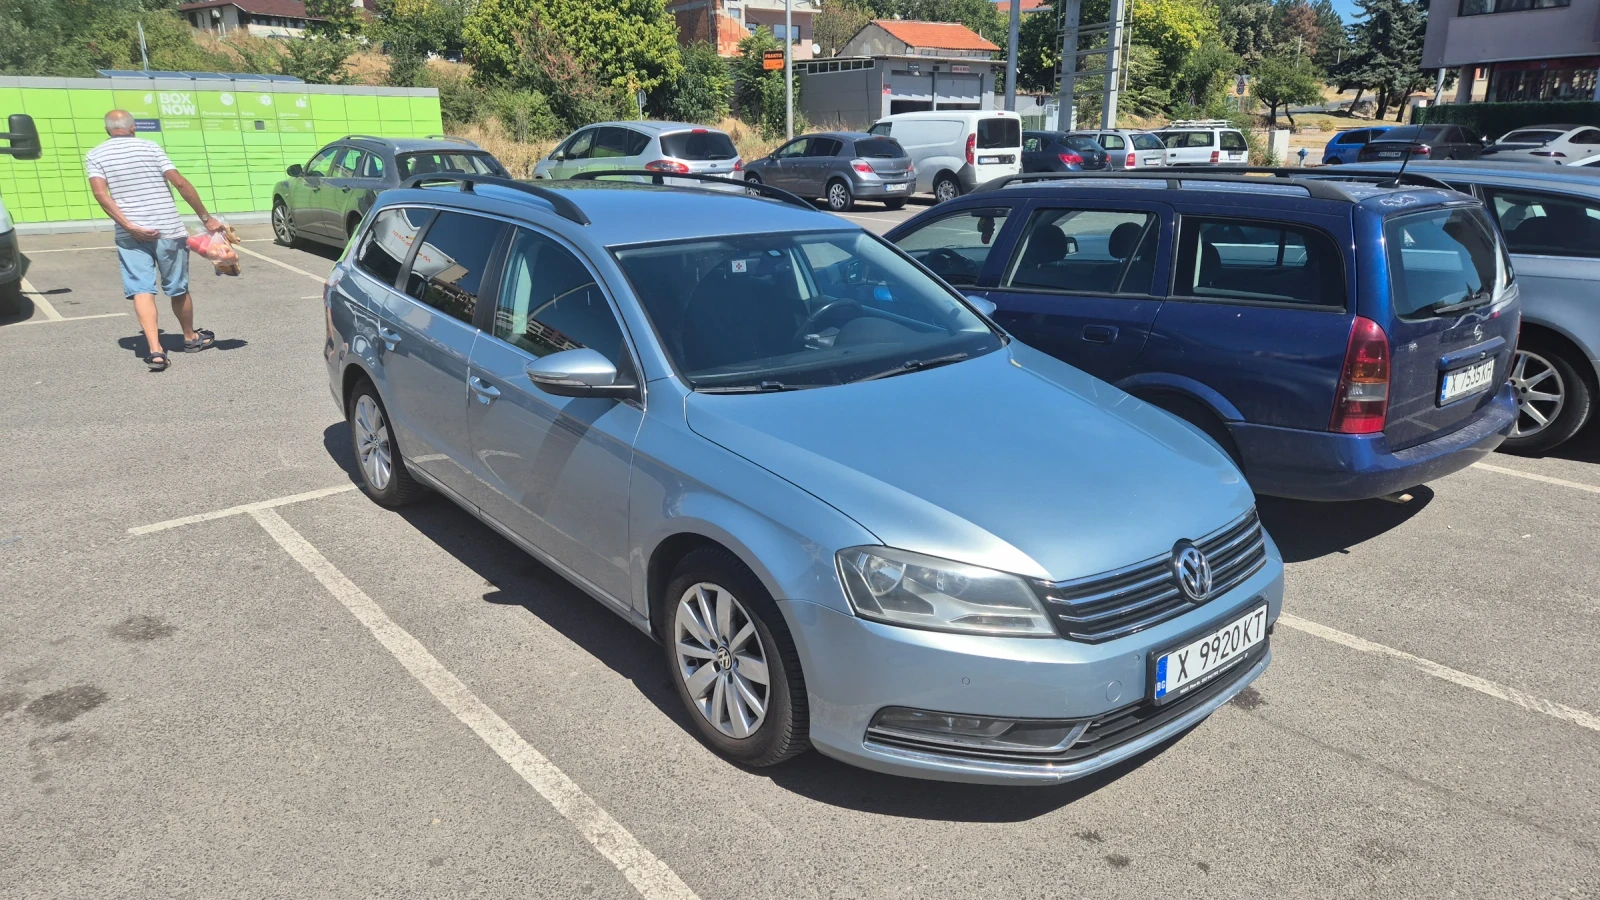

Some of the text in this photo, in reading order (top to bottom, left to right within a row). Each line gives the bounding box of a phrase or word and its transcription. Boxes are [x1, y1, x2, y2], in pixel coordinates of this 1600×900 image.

[159, 93, 191, 104] BOX
[161, 104, 196, 116] NOW
[1177, 650, 1189, 683] X
[1156, 680, 1166, 692] BG
